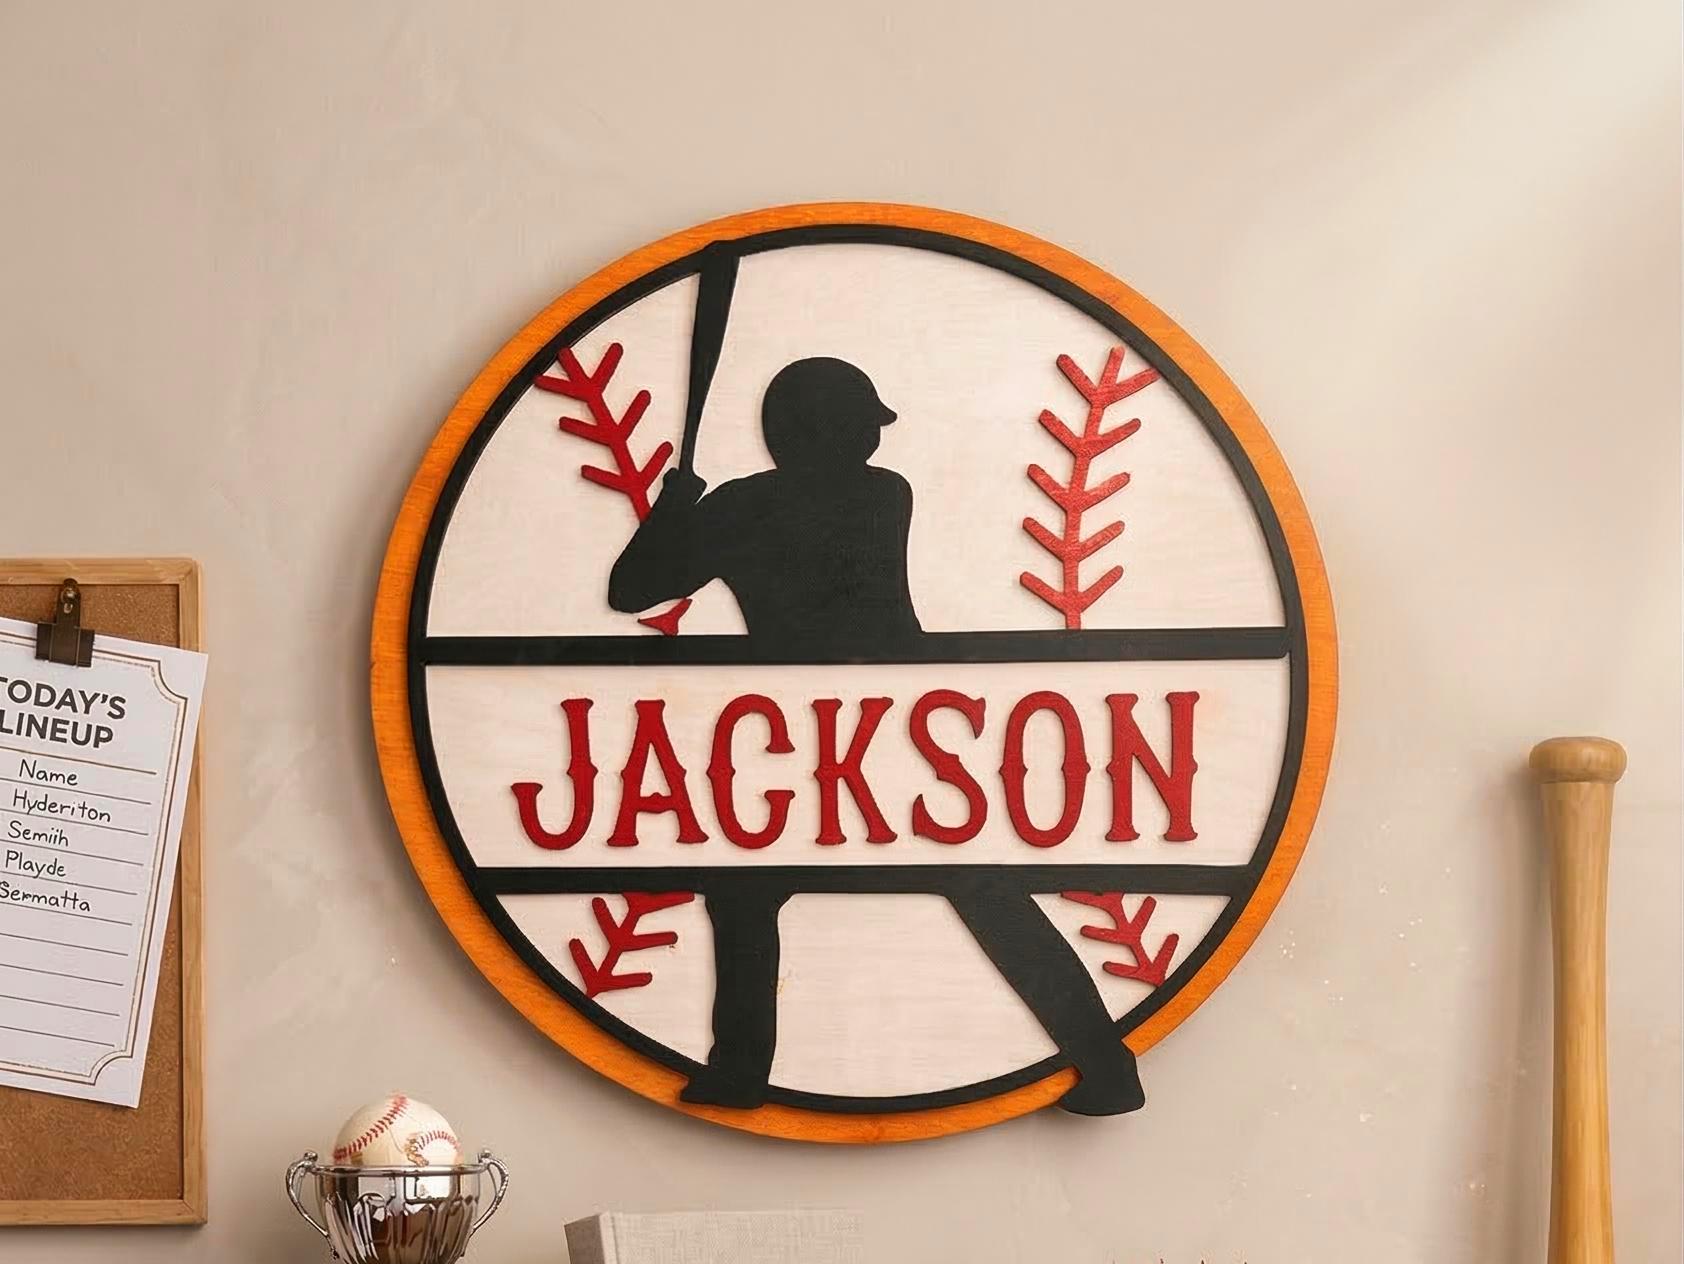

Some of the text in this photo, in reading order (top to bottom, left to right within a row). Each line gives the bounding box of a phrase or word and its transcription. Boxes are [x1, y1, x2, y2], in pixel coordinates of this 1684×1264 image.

[0, 709, 113, 748] LINEUP
[19, 758, 78, 786] Name
[510, 688, 1200, 851] JACKSON
[13, 788, 111, 823] Hyderiton
[5, 849, 66, 878] Playde
[0, 880, 90, 911] Sermatta
